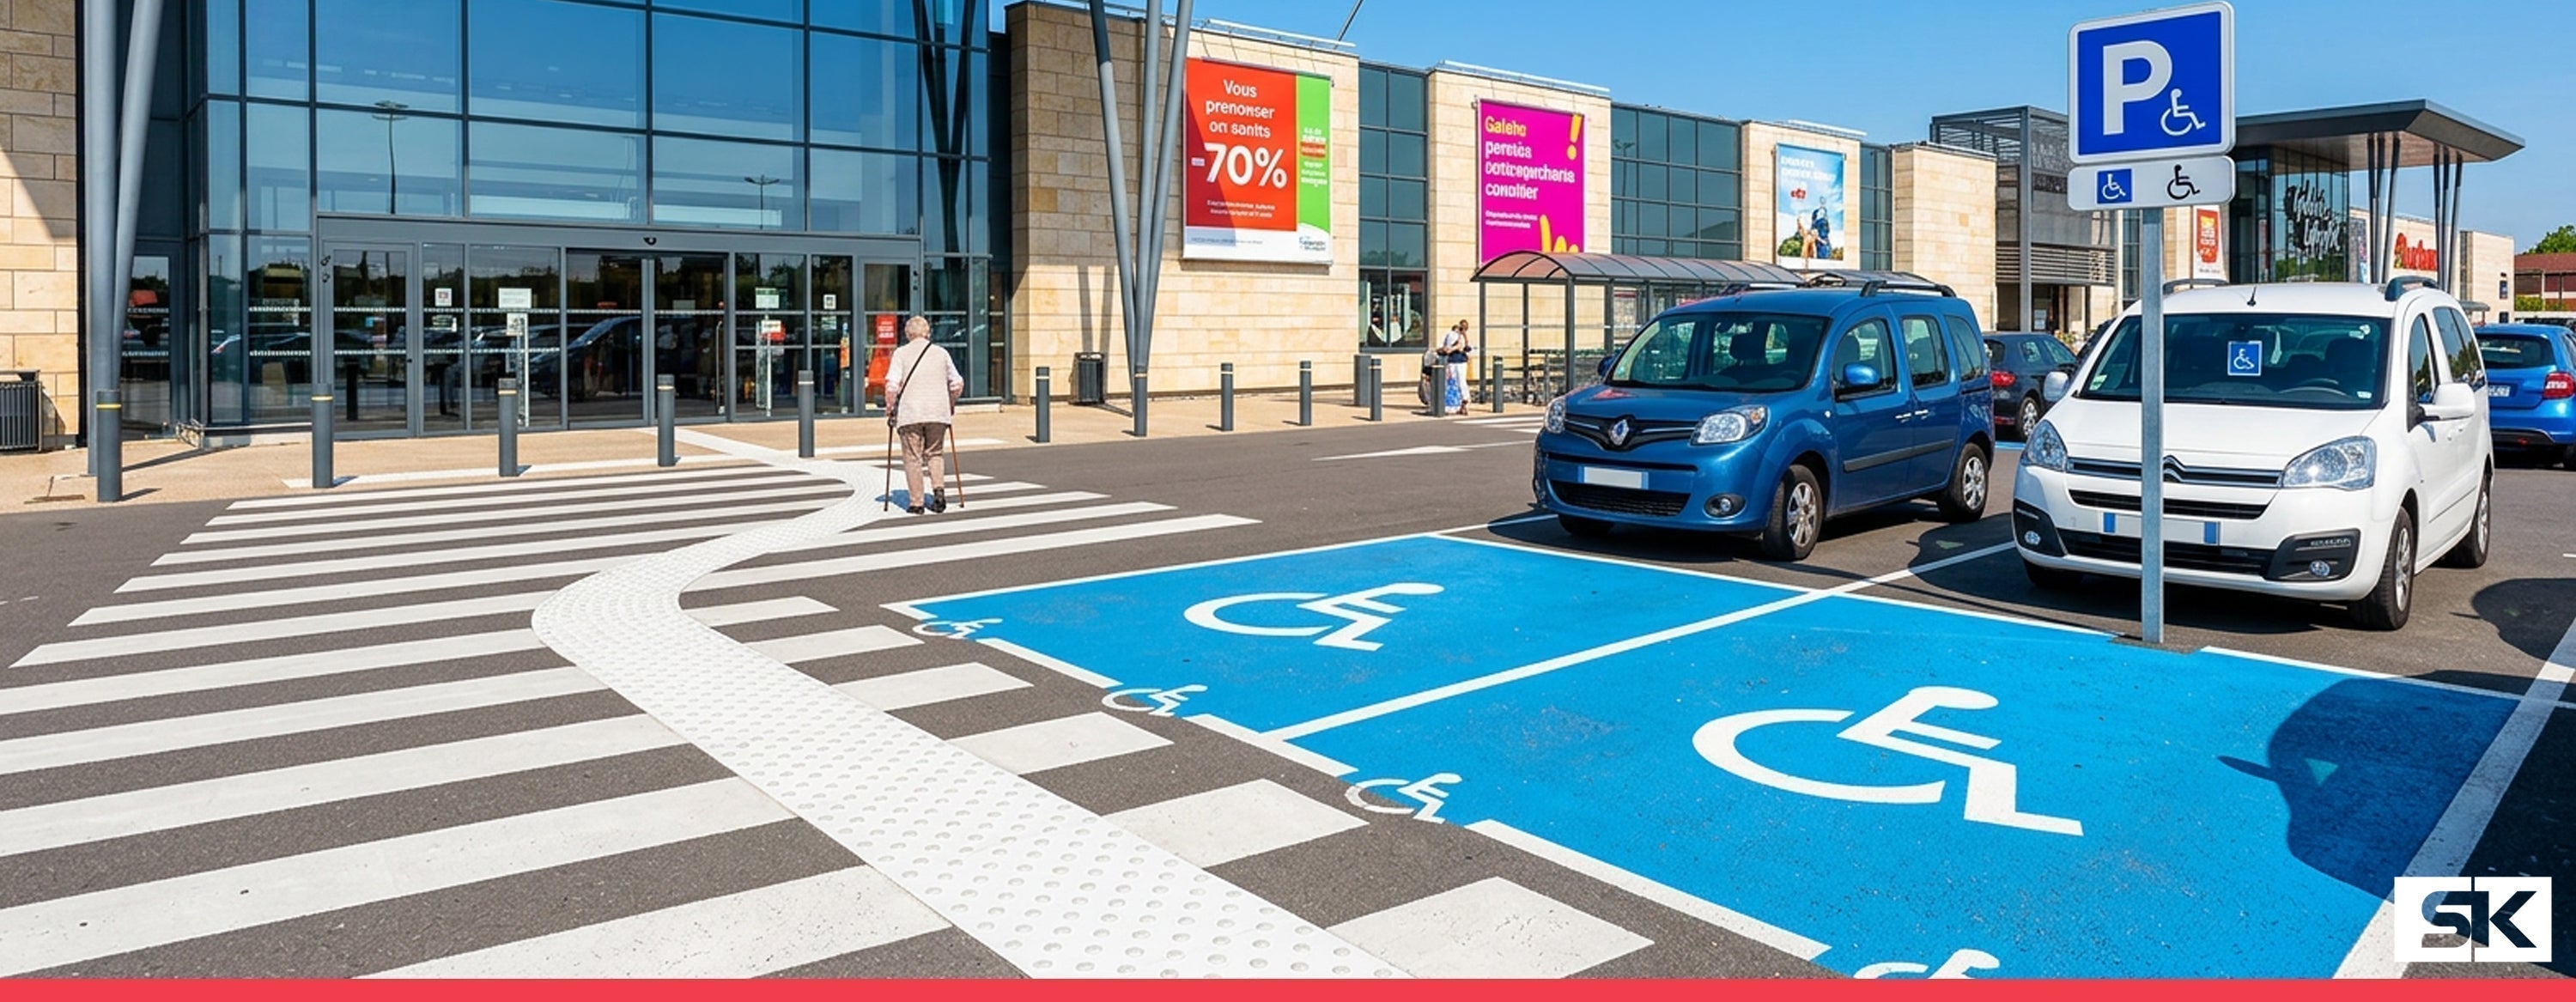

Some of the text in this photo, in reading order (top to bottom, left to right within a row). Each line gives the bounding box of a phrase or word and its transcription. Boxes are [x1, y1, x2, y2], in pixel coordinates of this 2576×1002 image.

[1223, 79, 1257, 98] Vous
[2103, 39, 2172, 136] P
[1192, 143, 1287, 189] -70%
